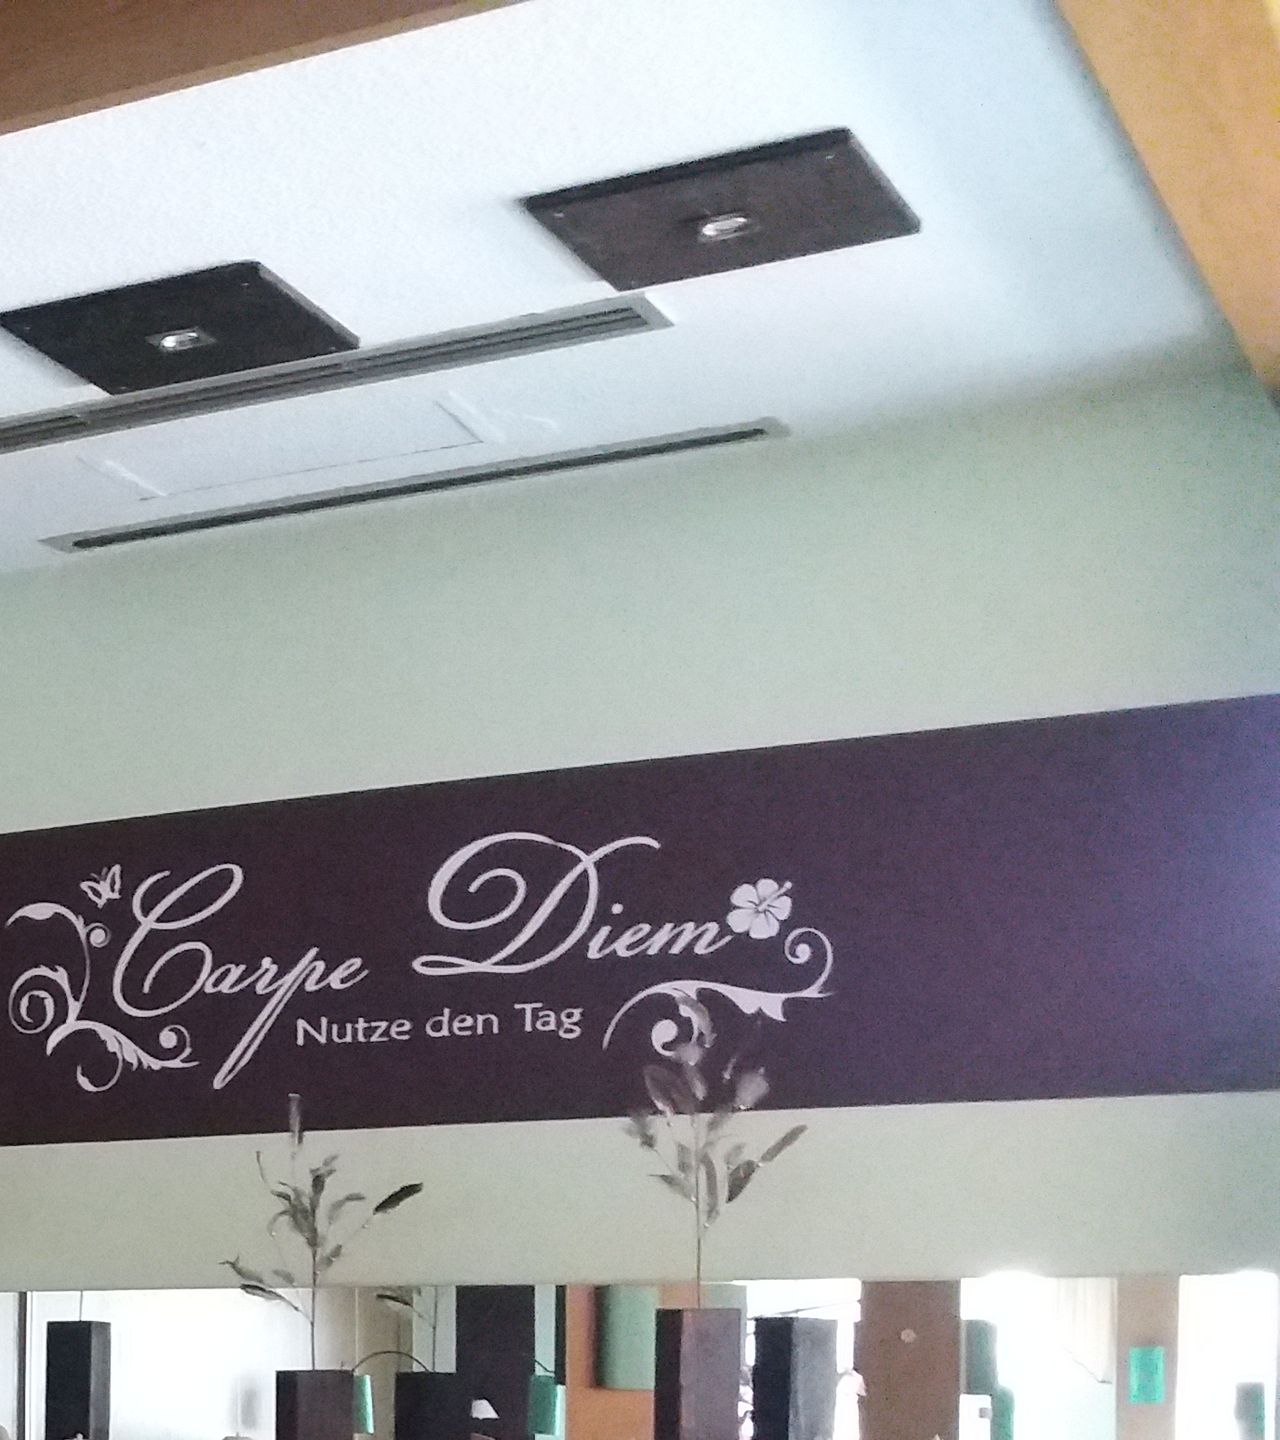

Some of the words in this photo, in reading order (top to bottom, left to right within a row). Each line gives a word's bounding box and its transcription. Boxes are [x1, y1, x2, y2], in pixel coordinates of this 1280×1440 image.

[113, 863, 370, 1090] Carpe
[410, 832, 734, 976] Diem
[296, 1015, 412, 1047] Nutze
[425, 1007, 500, 1039] den
[513, 1002, 585, 1040] Tag
